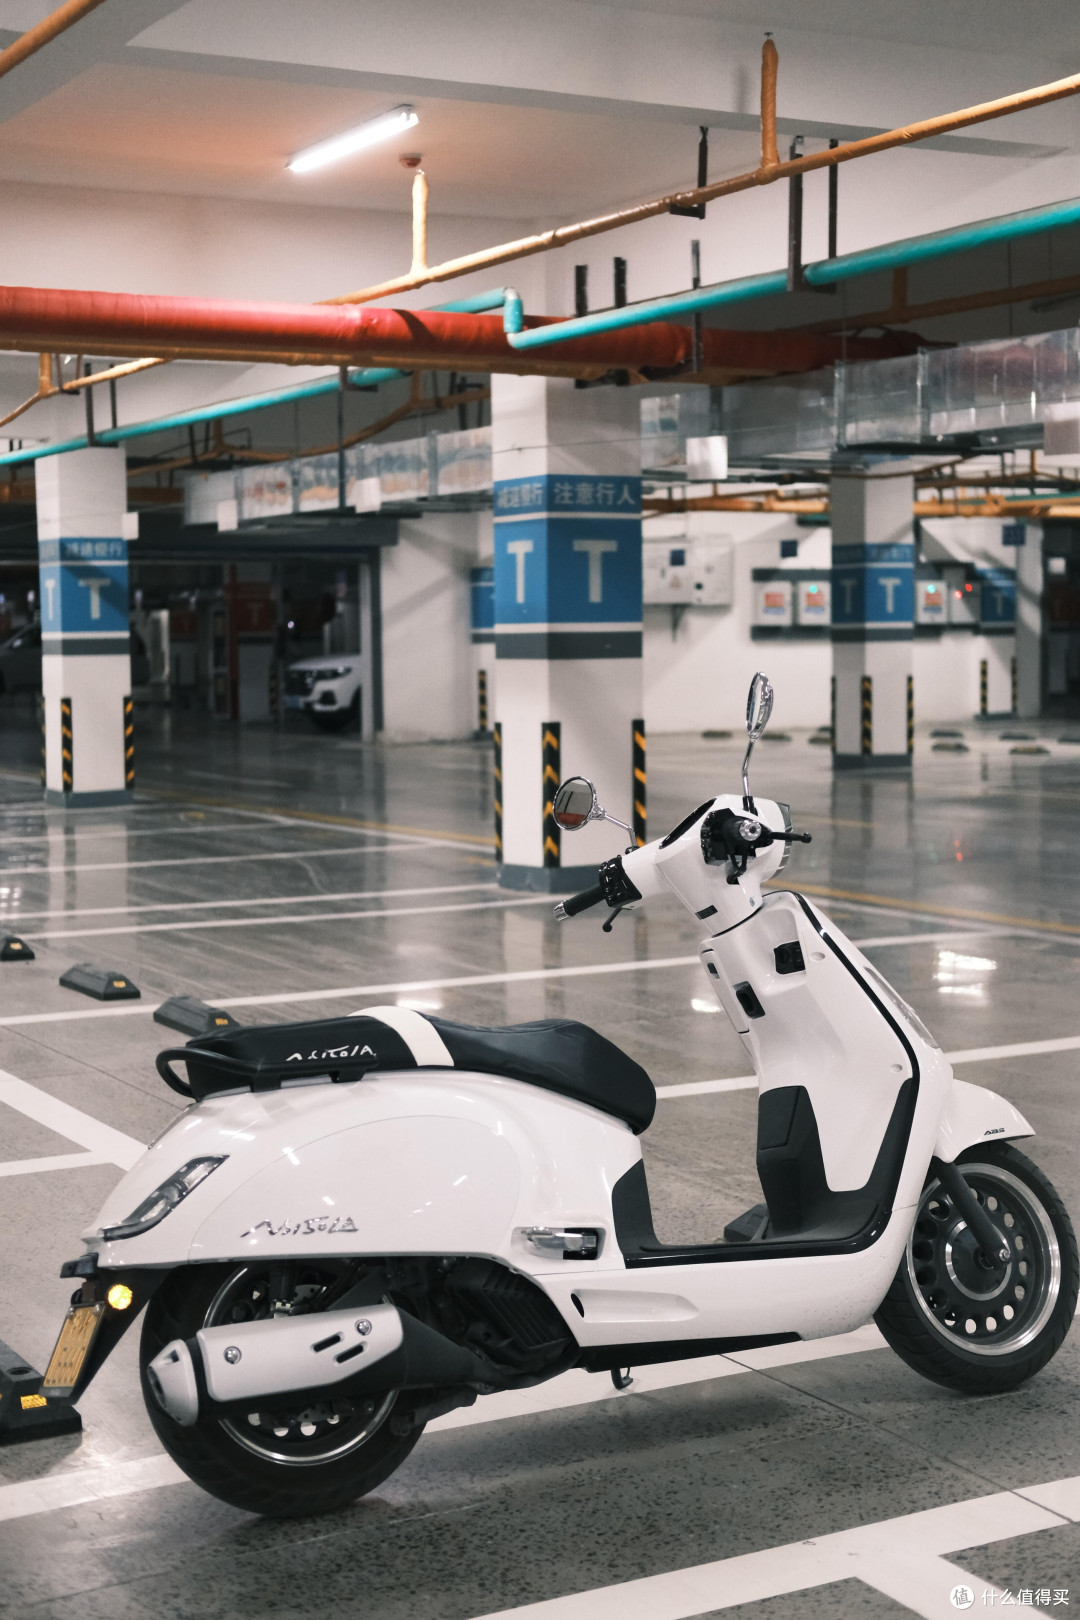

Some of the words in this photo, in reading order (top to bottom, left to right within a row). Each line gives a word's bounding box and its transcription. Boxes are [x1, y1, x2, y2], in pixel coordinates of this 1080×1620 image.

[553, 482, 636, 506] 注意行人
[507, 540, 534, 604] T
[572, 540, 618, 603] T
[78, 578, 111, 621] T
[878, 577, 902, 614] T
[984, 1127, 1006, 1136] ABS
